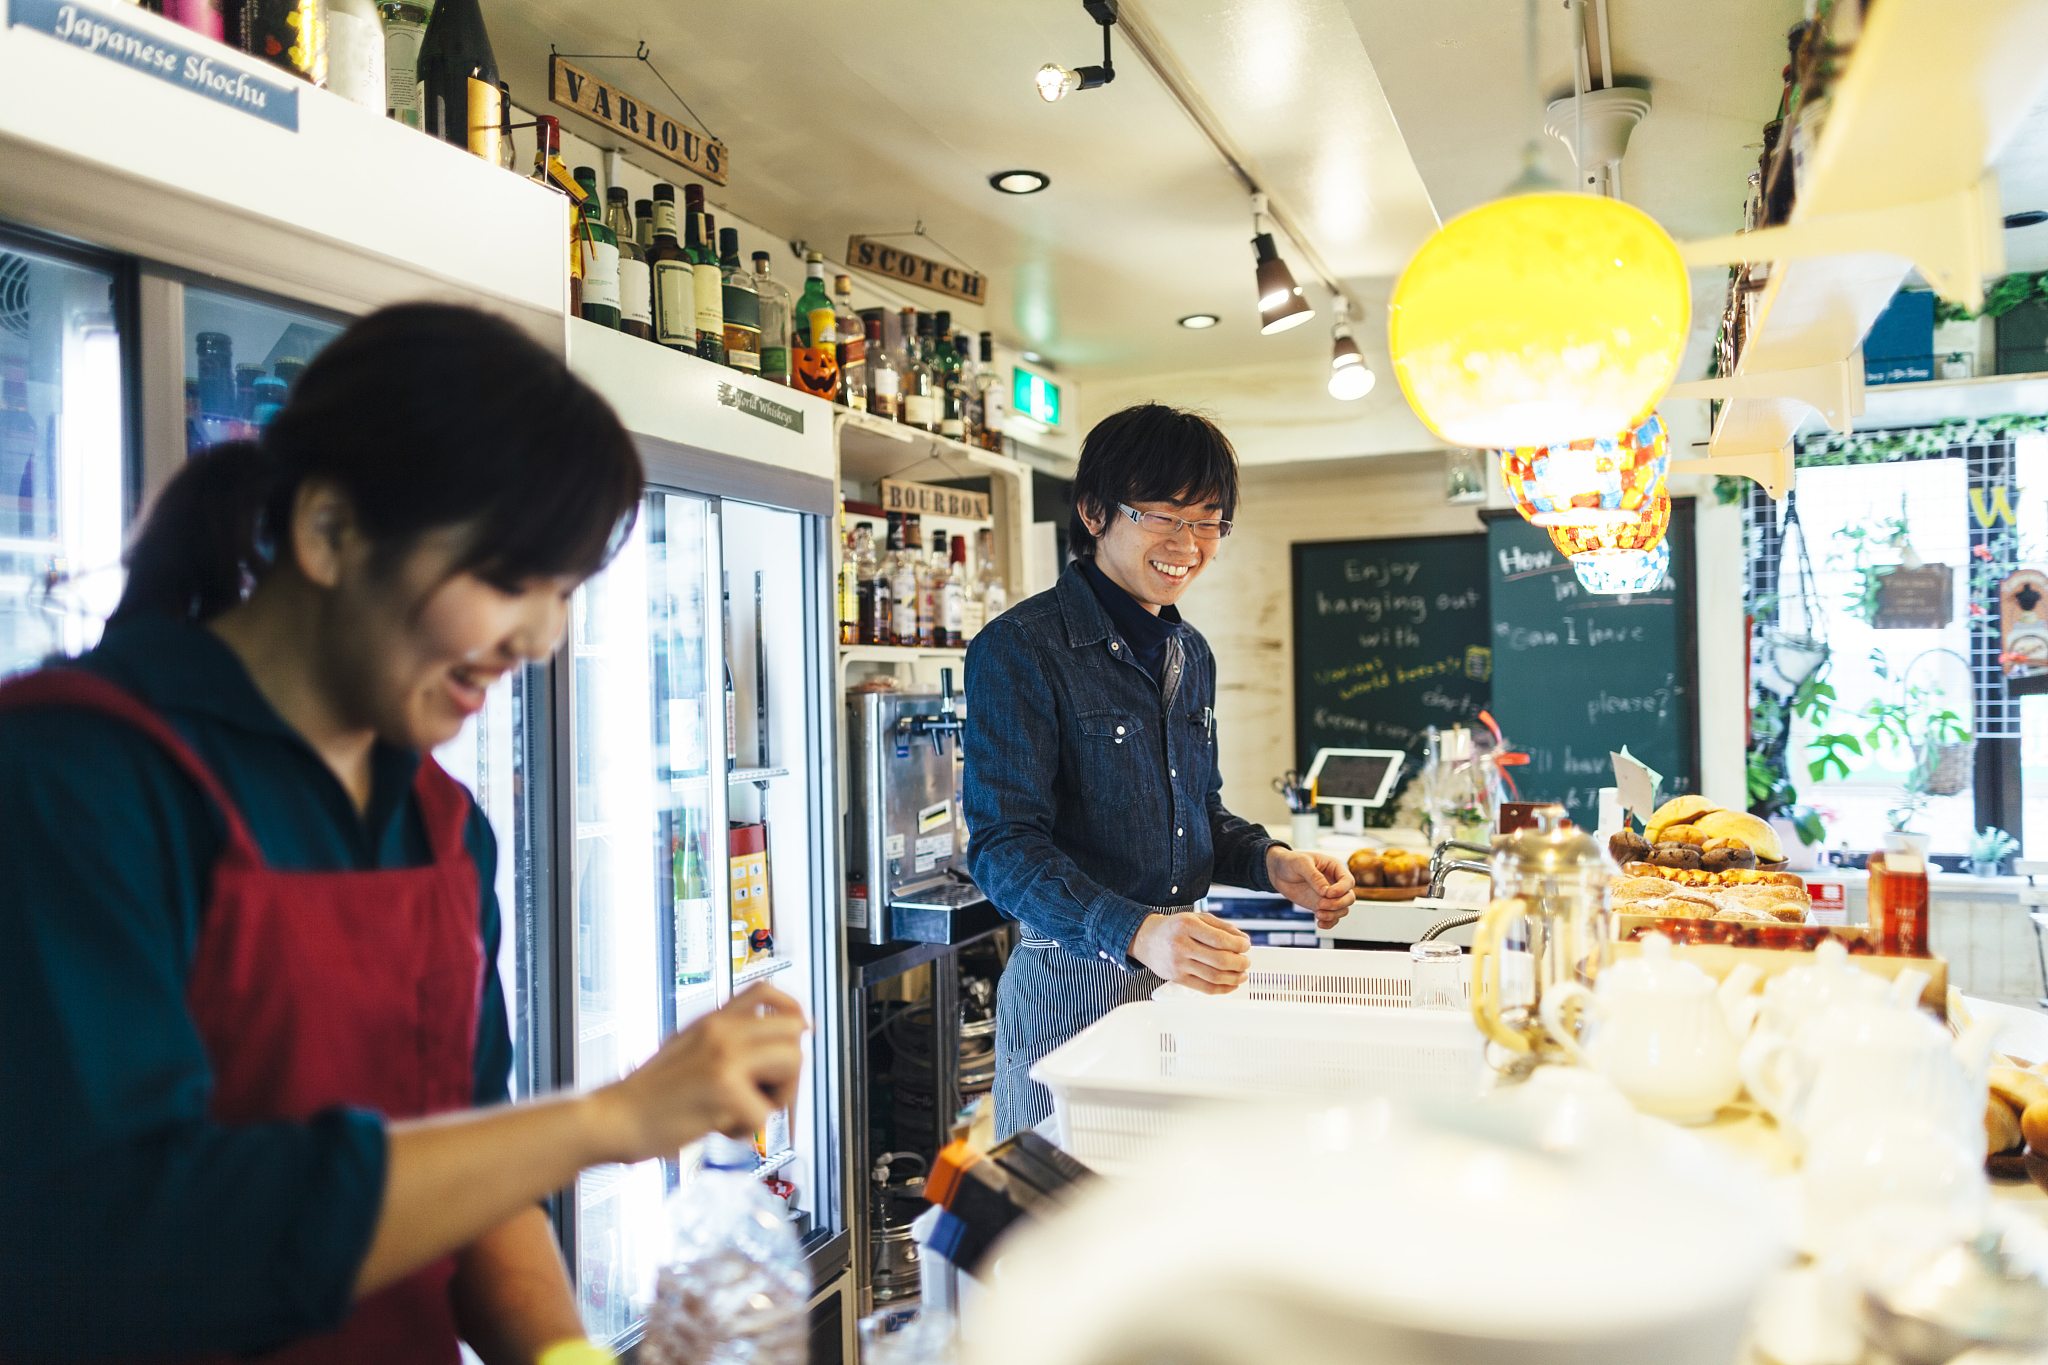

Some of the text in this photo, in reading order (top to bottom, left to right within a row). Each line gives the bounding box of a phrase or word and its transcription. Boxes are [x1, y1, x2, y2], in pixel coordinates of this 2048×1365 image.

[56, 5, 177, 71] Japanese
[184, 56, 267, 108] Shochu
[565, 68, 720, 174] VARIOUS
[858, 242, 979, 297] SCOTCH
[734, 392, 793, 427] World Whiskeys
[890, 485, 983, 519] BOURBON
[1344, 558, 1421, 588] Enjoy
[1499, 546, 1553, 575] How
[1317, 588, 1480, 624] hanging out
[1359, 625, 1420, 647] with
[1587, 618, 1643, 647] have
[1564, 745, 1617, 775] hav
